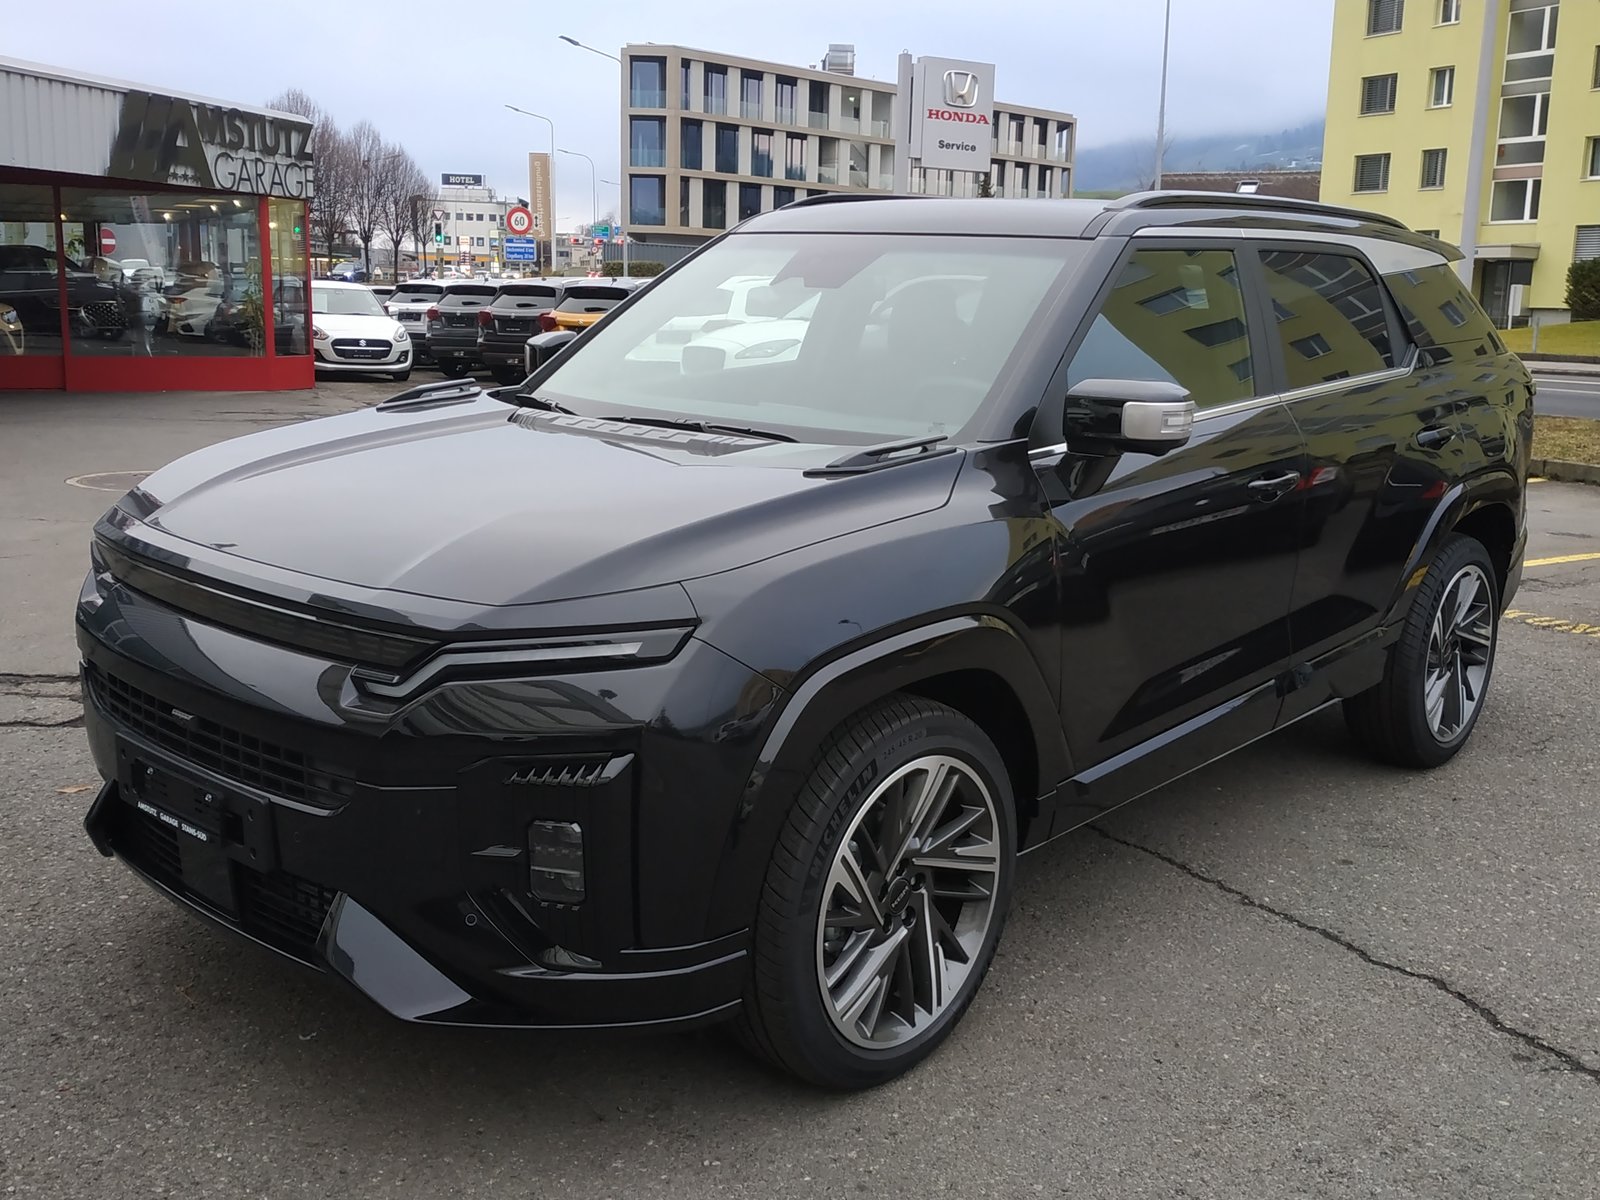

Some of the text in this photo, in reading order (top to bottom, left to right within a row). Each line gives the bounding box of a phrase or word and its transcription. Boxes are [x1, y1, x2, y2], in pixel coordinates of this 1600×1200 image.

[927, 108, 990, 125] HONDA
[938, 139, 977, 152] Service
[214, 150, 314, 198] GARAGE
[449, 175, 475, 184] HOTEL
[514, 216, 525, 226] 60
[159, 812, 179, 828] GARAGE
[809, 764, 875, 878] MICHELIN
